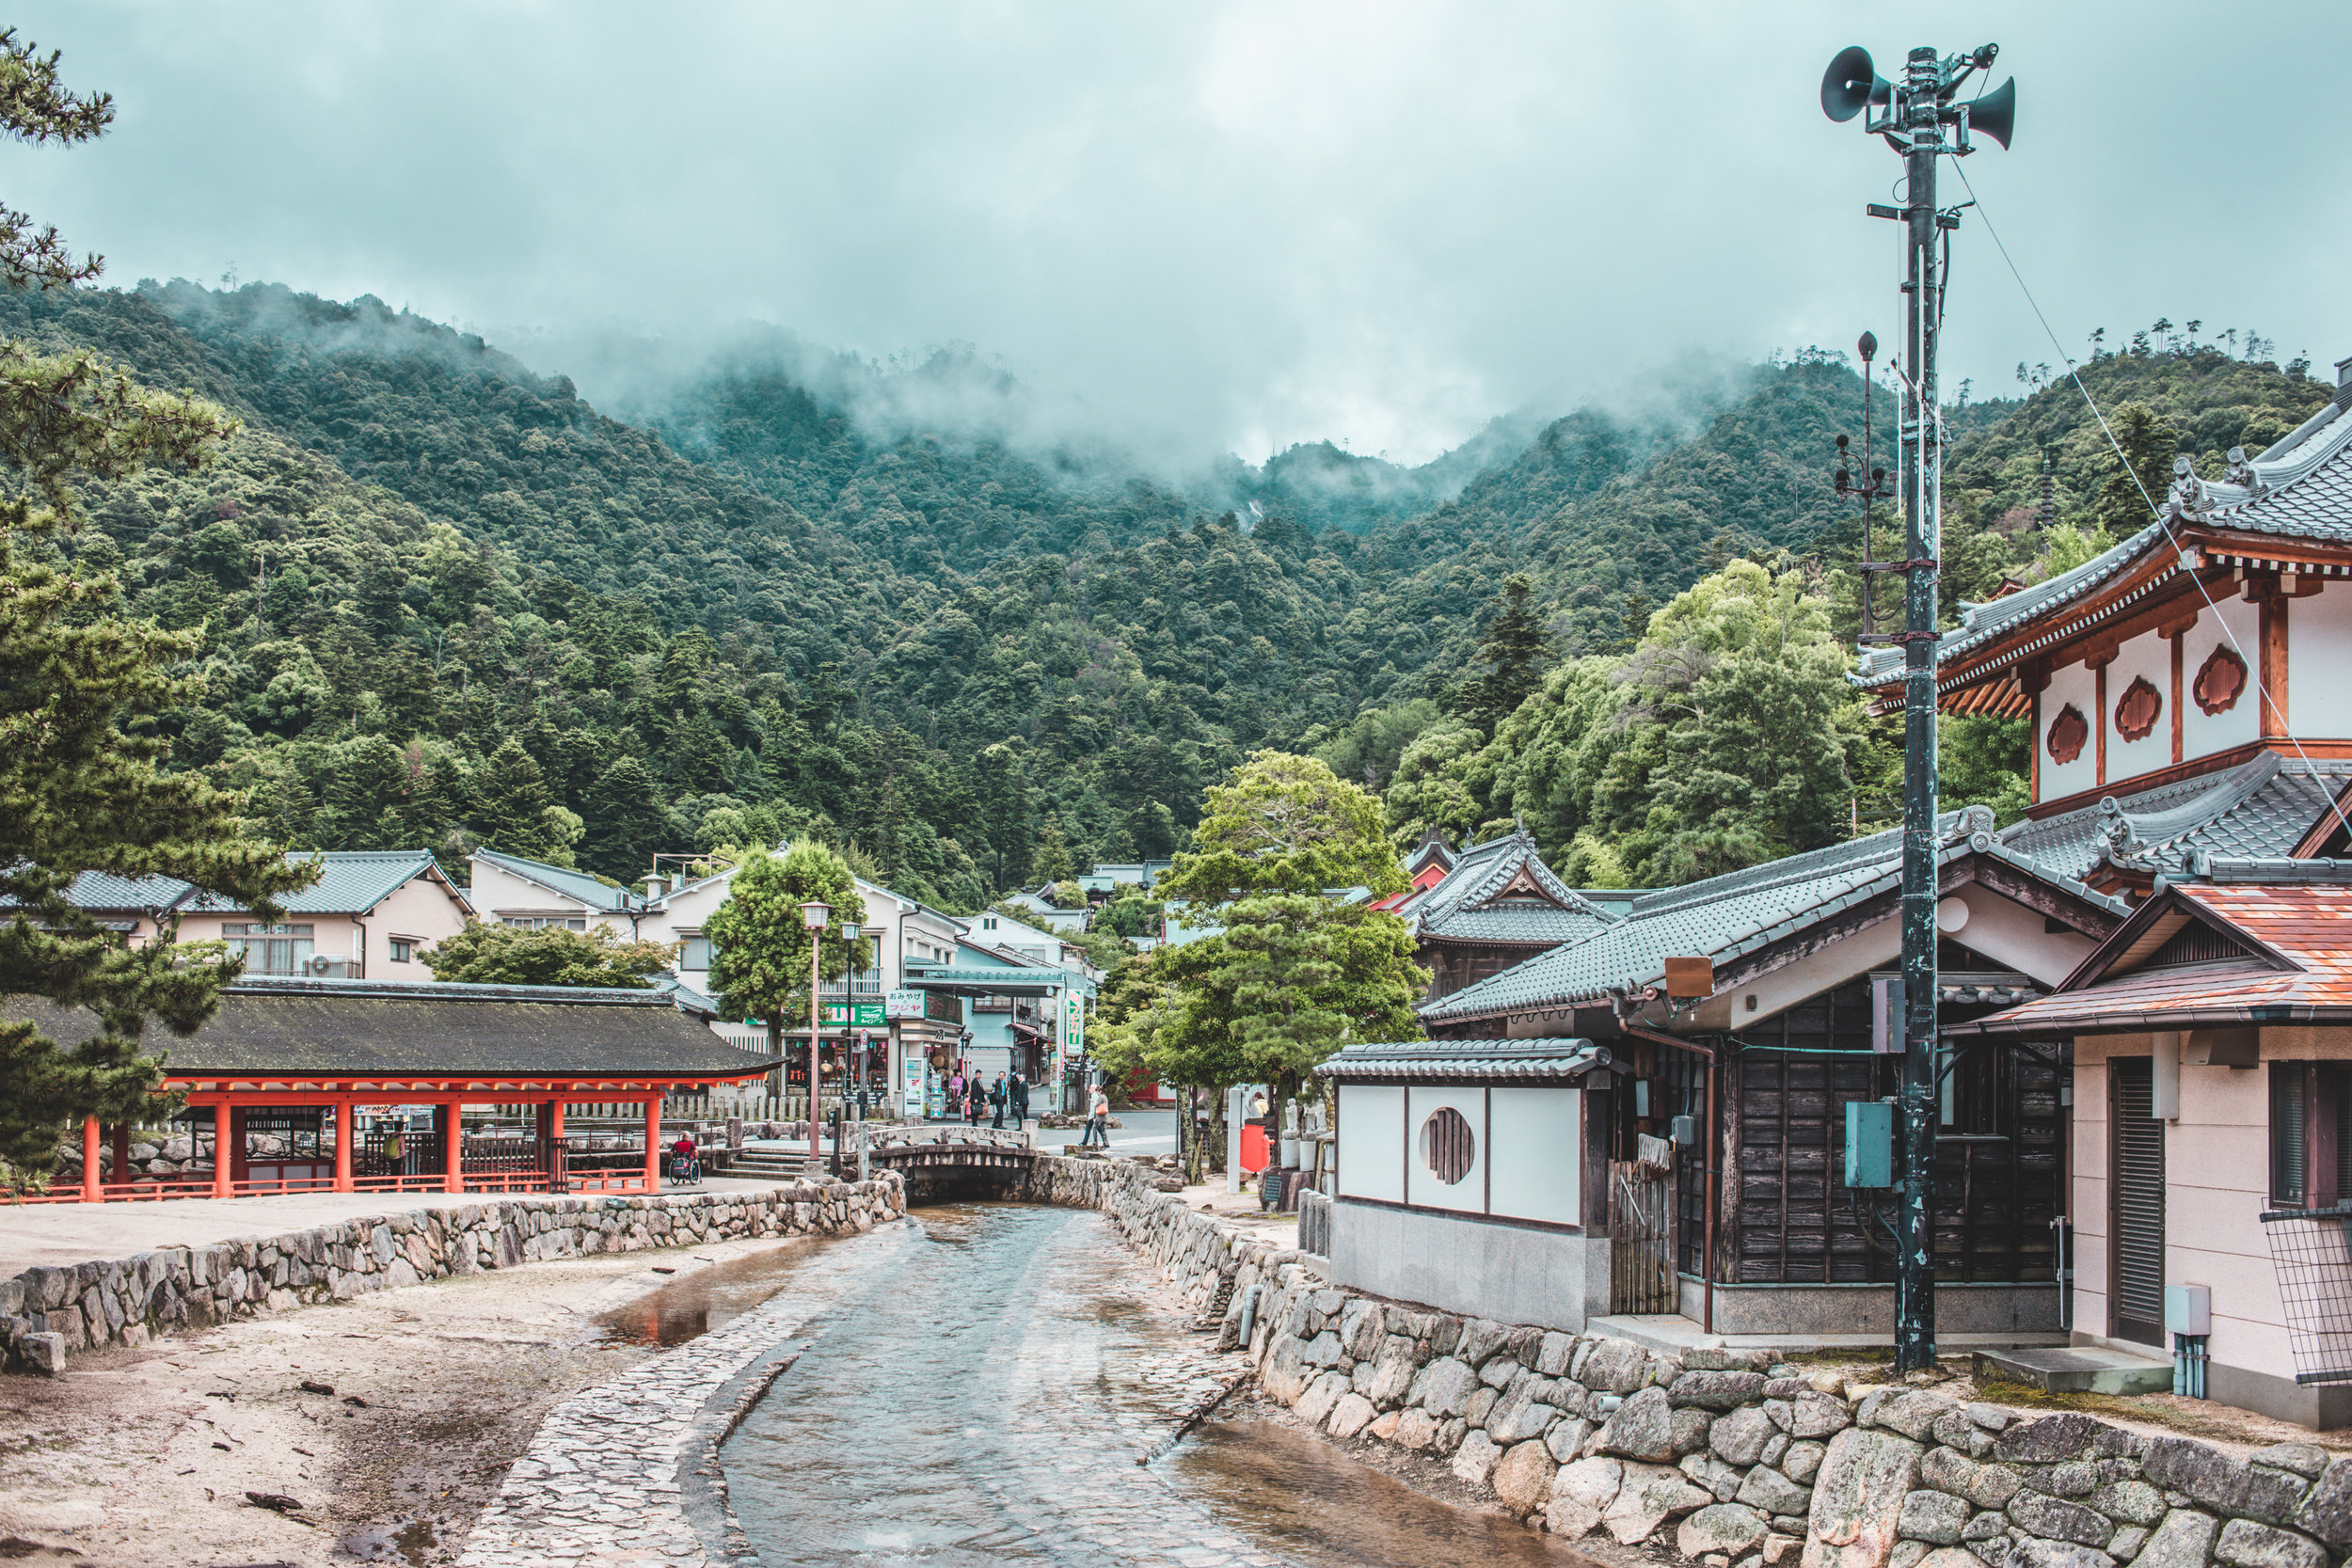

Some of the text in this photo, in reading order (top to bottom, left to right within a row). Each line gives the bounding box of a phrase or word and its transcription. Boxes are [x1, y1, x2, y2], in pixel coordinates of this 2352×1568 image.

[1071, 1006, 1079, 1044] フジカラー
